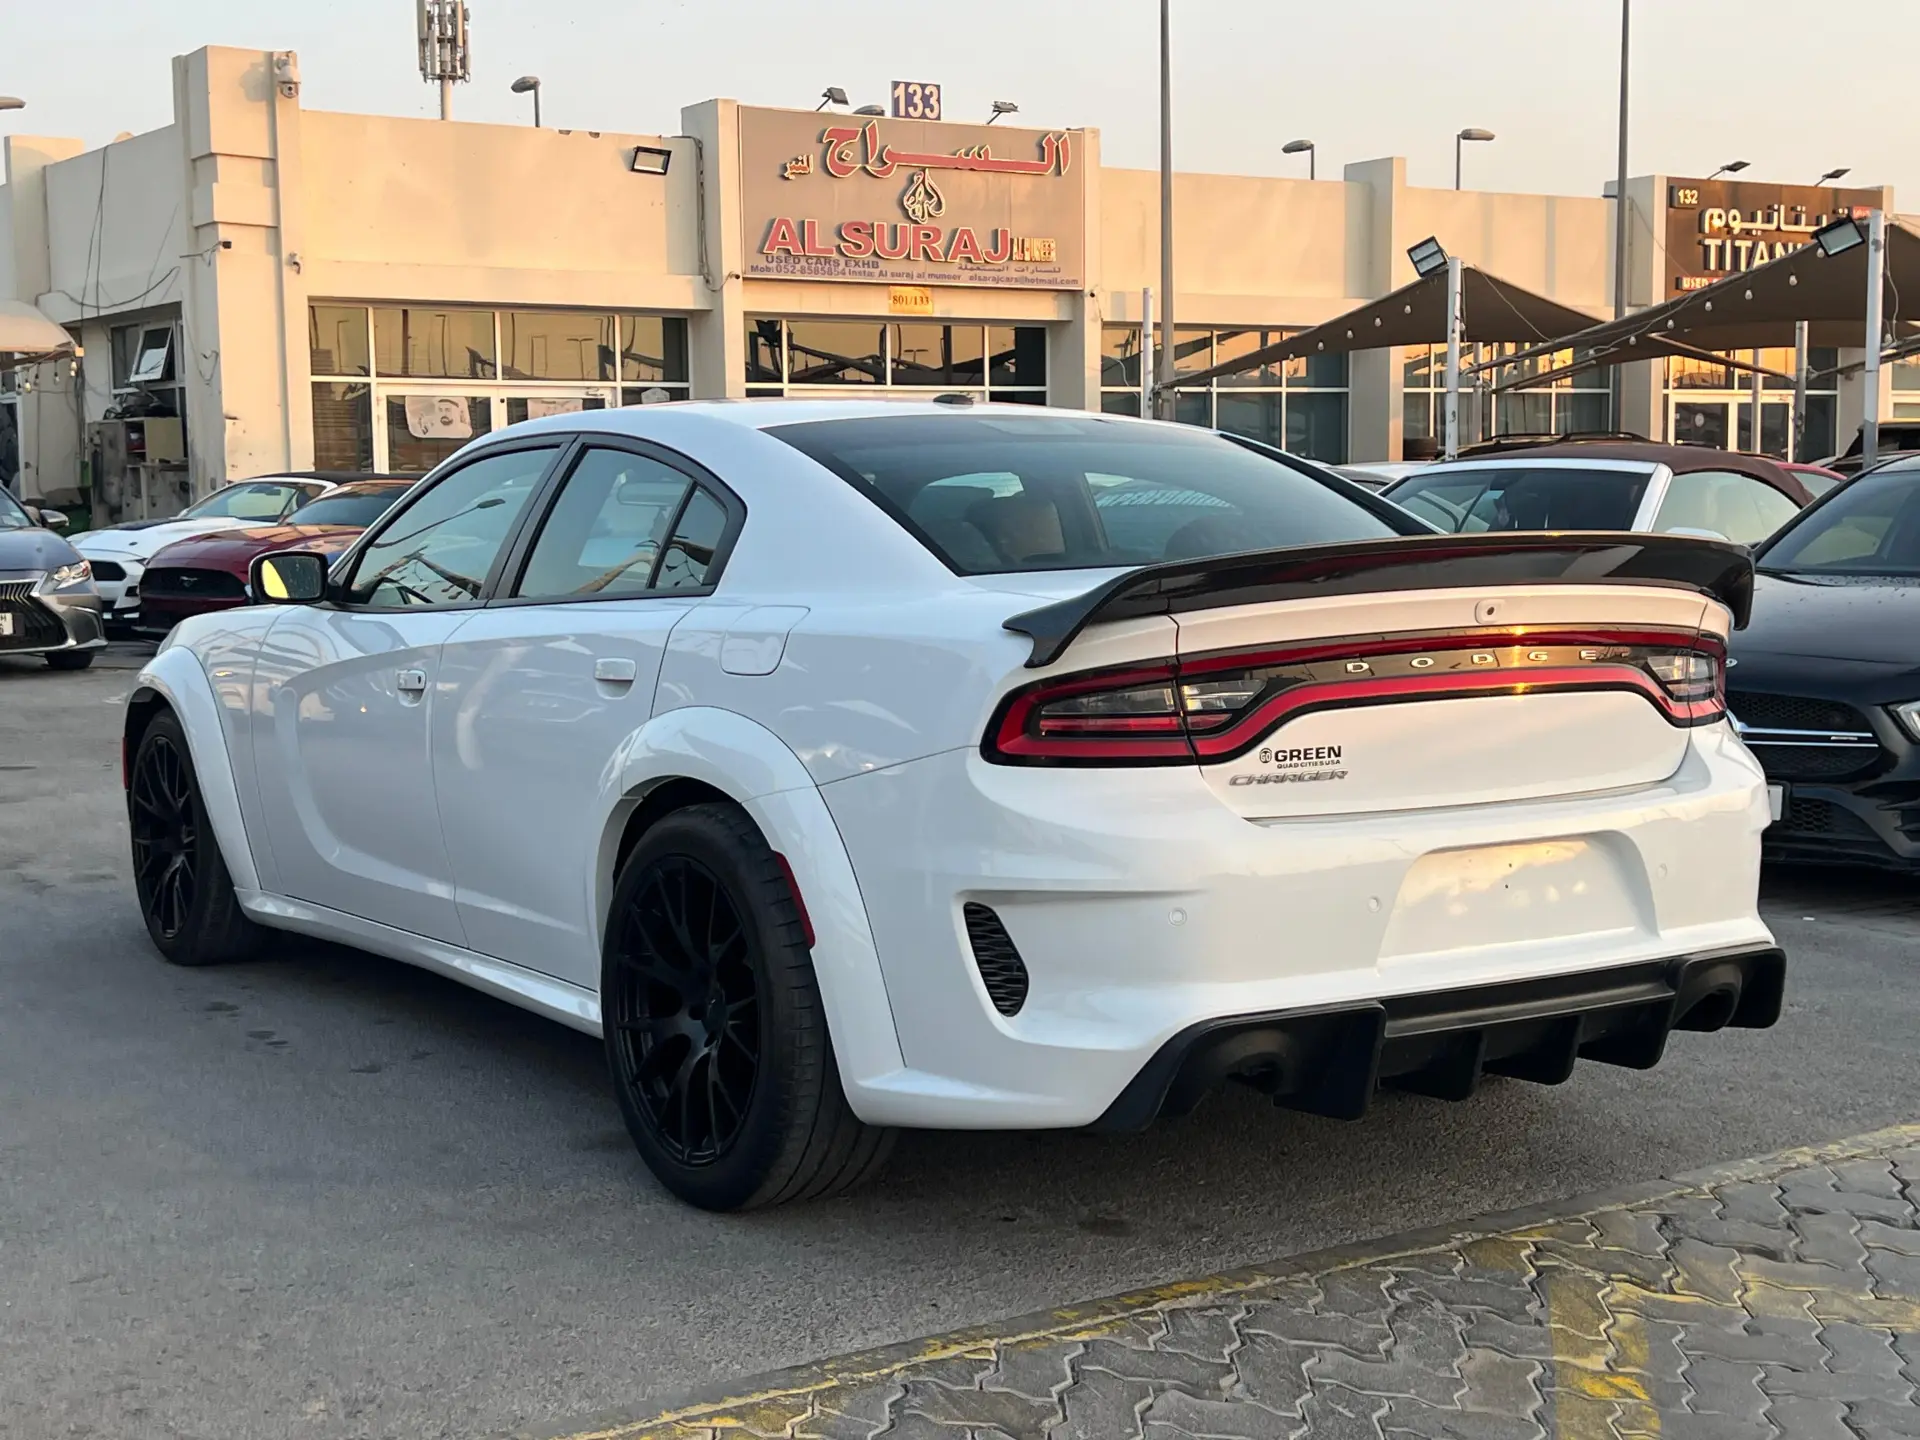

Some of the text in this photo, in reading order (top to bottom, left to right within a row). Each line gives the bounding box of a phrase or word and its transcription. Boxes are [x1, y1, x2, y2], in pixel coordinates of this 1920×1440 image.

[894, 82, 940, 120] 133
[822, 119, 1071, 179] السراج
[1678, 189, 1698, 204] 132
[763, 217, 1012, 264] AL SURAJ
[766, 255, 879, 269] USED CARS EXHB
[892, 294, 930, 306] 801/133
[1345, 649, 1598, 673] DODGE
[1275, 745, 1342, 762] GREEN
[1300, 760, 1324, 768] CITIES
[1228, 769, 1349, 786] CHARGER
